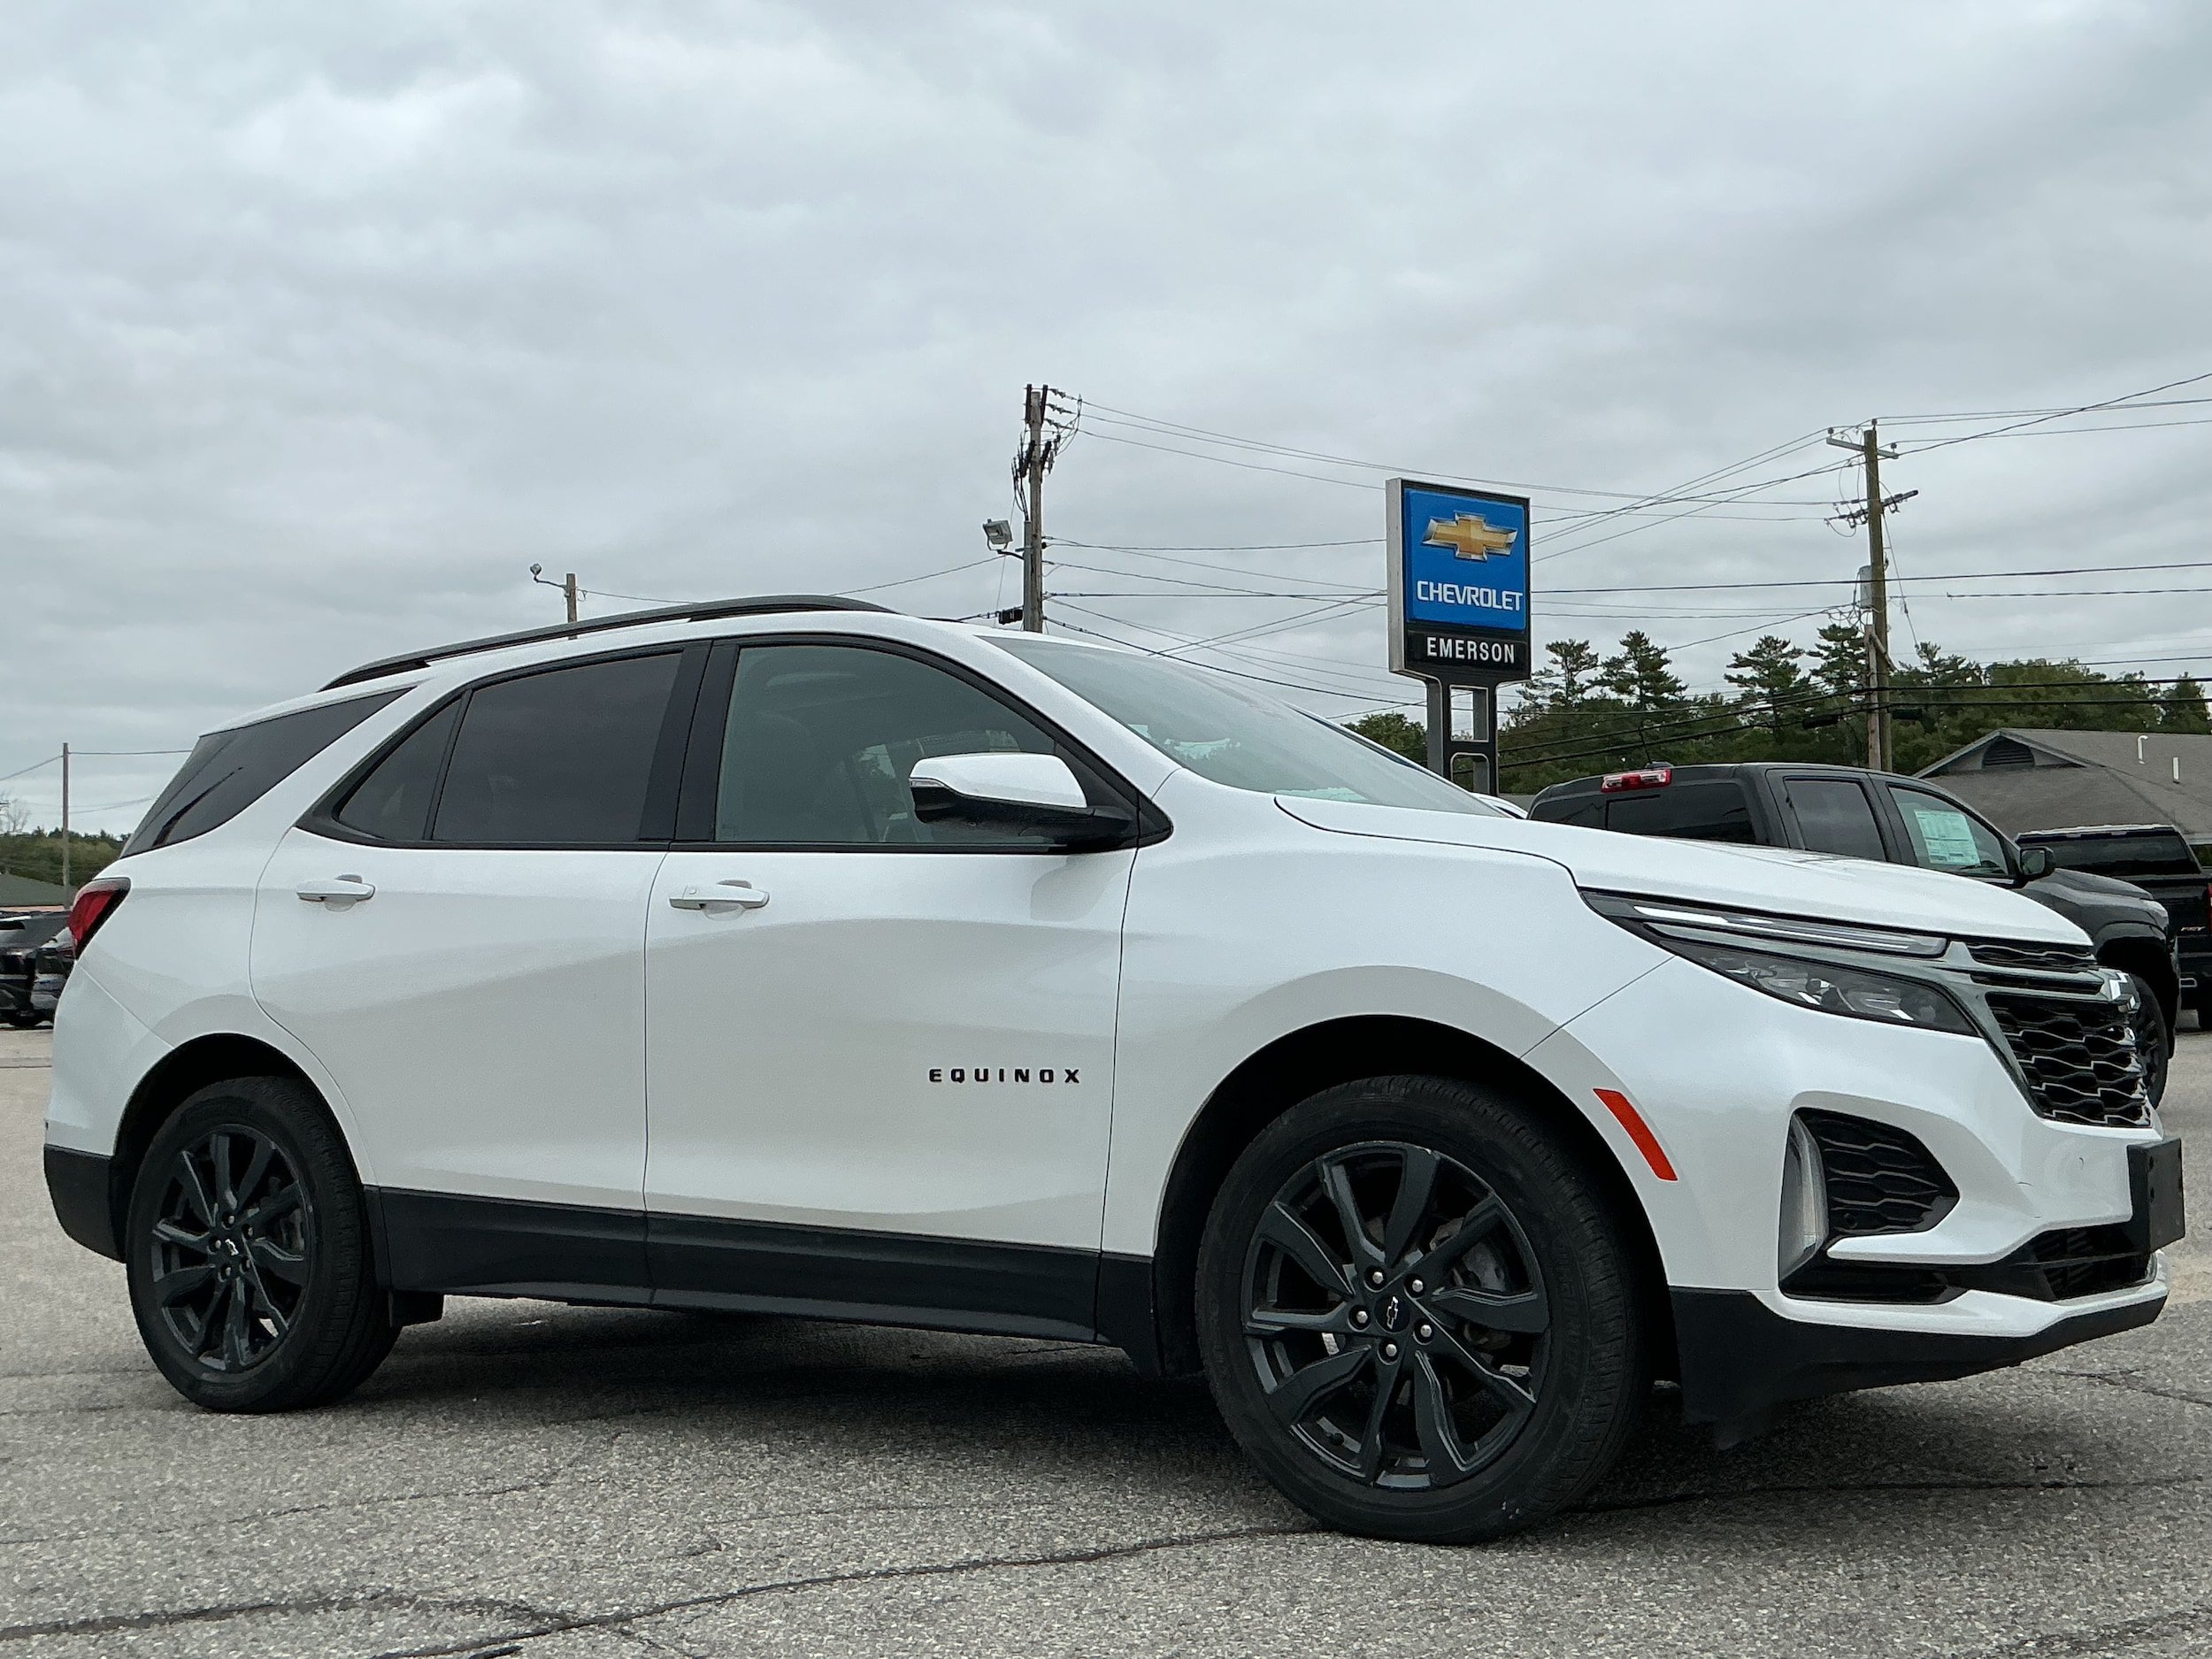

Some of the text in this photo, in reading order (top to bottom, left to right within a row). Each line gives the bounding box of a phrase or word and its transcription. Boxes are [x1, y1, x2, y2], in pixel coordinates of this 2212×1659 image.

[1417, 581, 1523, 611] CHEVROLET
[1426, 636, 1515, 664] EMERSON
[928, 1068, 1080, 1084] EQUINOX
